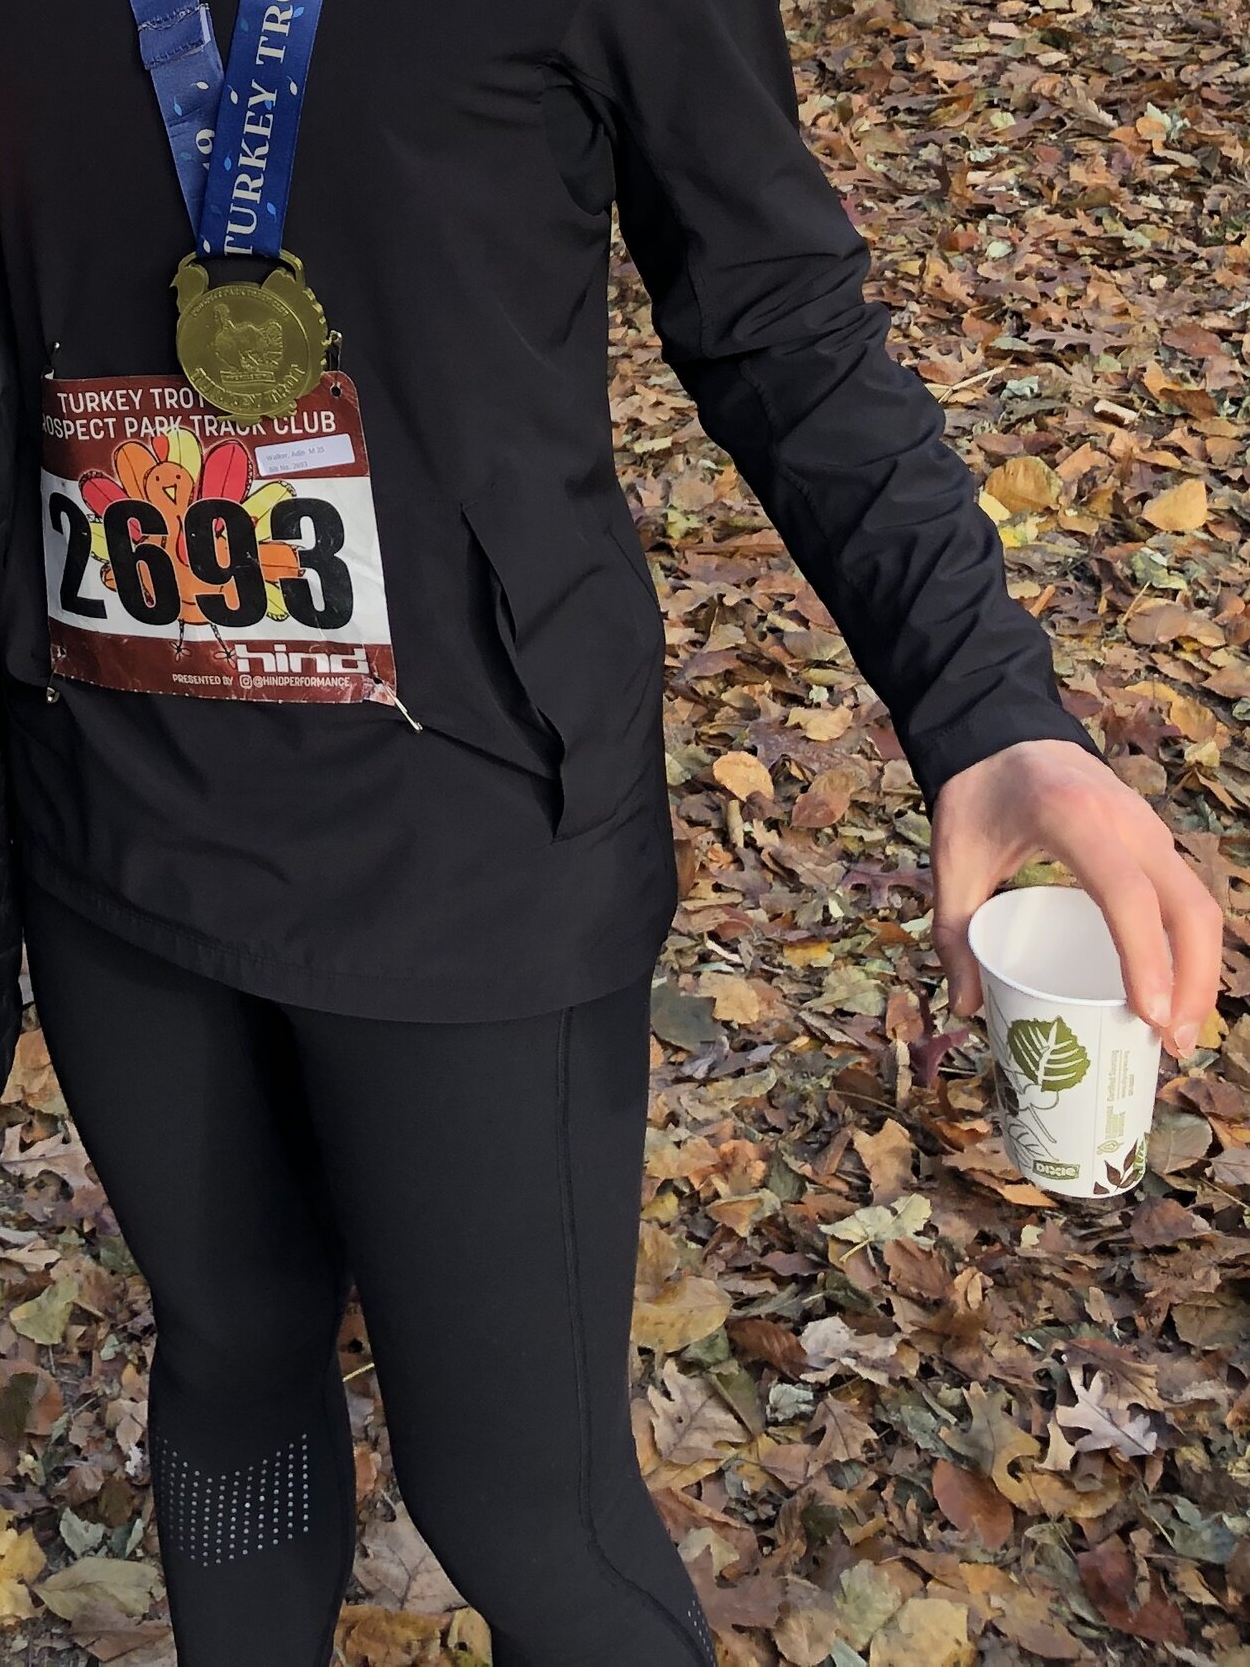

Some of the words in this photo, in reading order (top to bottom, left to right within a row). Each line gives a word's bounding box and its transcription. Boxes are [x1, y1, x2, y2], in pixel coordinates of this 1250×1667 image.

[223, 78, 279, 256] TURKEY
[57, 388, 142, 413] TURKEY
[124, 413, 183, 438] PARK
[273, 410, 337, 436] CLUB
[49, 491, 354, 630] 2693
[234, 644, 370, 674] hind
[172, 674, 222, 685] PRESENTED
[222, 676, 234, 685] BY
[253, 675, 350, 687] @HINDPERFORMANCE
